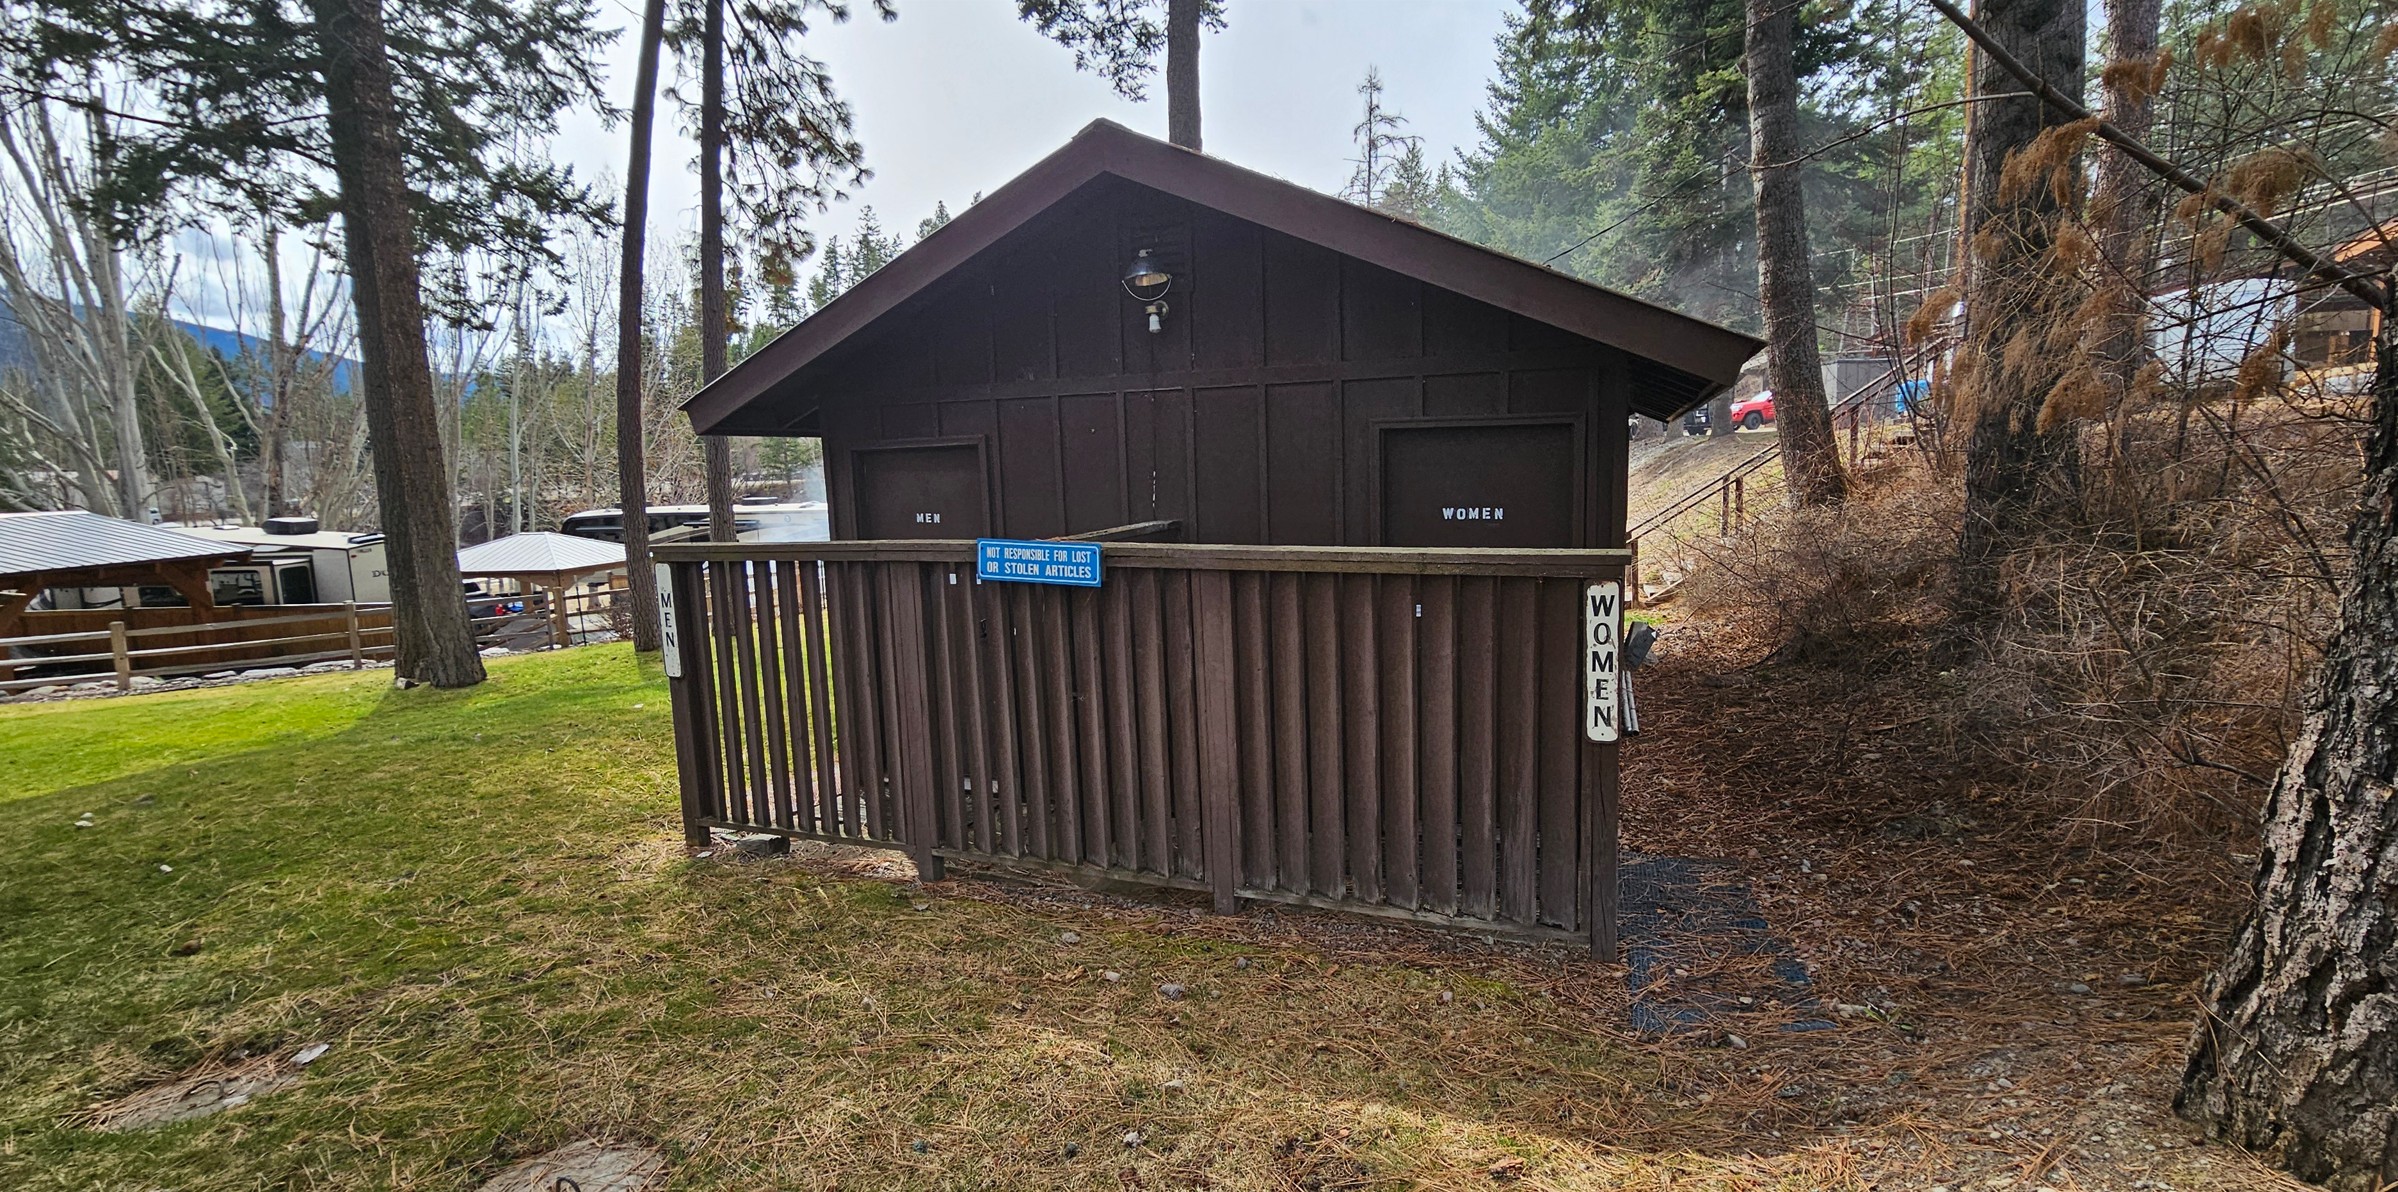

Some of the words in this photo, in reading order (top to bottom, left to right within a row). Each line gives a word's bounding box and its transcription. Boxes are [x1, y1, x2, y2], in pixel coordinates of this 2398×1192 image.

[916, 513, 940, 523] MEN
[1442, 507, 1504, 520] WOMEN
[986, 547, 1000, 558] NOT
[1004, 548, 1050, 561] RESPONSIBLE
[1053, 550, 1068, 562] FOR
[1071, 551, 1091, 563] LOST
[986, 561, 999, 573] OR
[1004, 562, 1040, 576] STOLEN
[1045, 564, 1092, 578] ARTICLES
[660, 592, 675, 648] MEN
[1590, 594, 1615, 727] WOMEN
